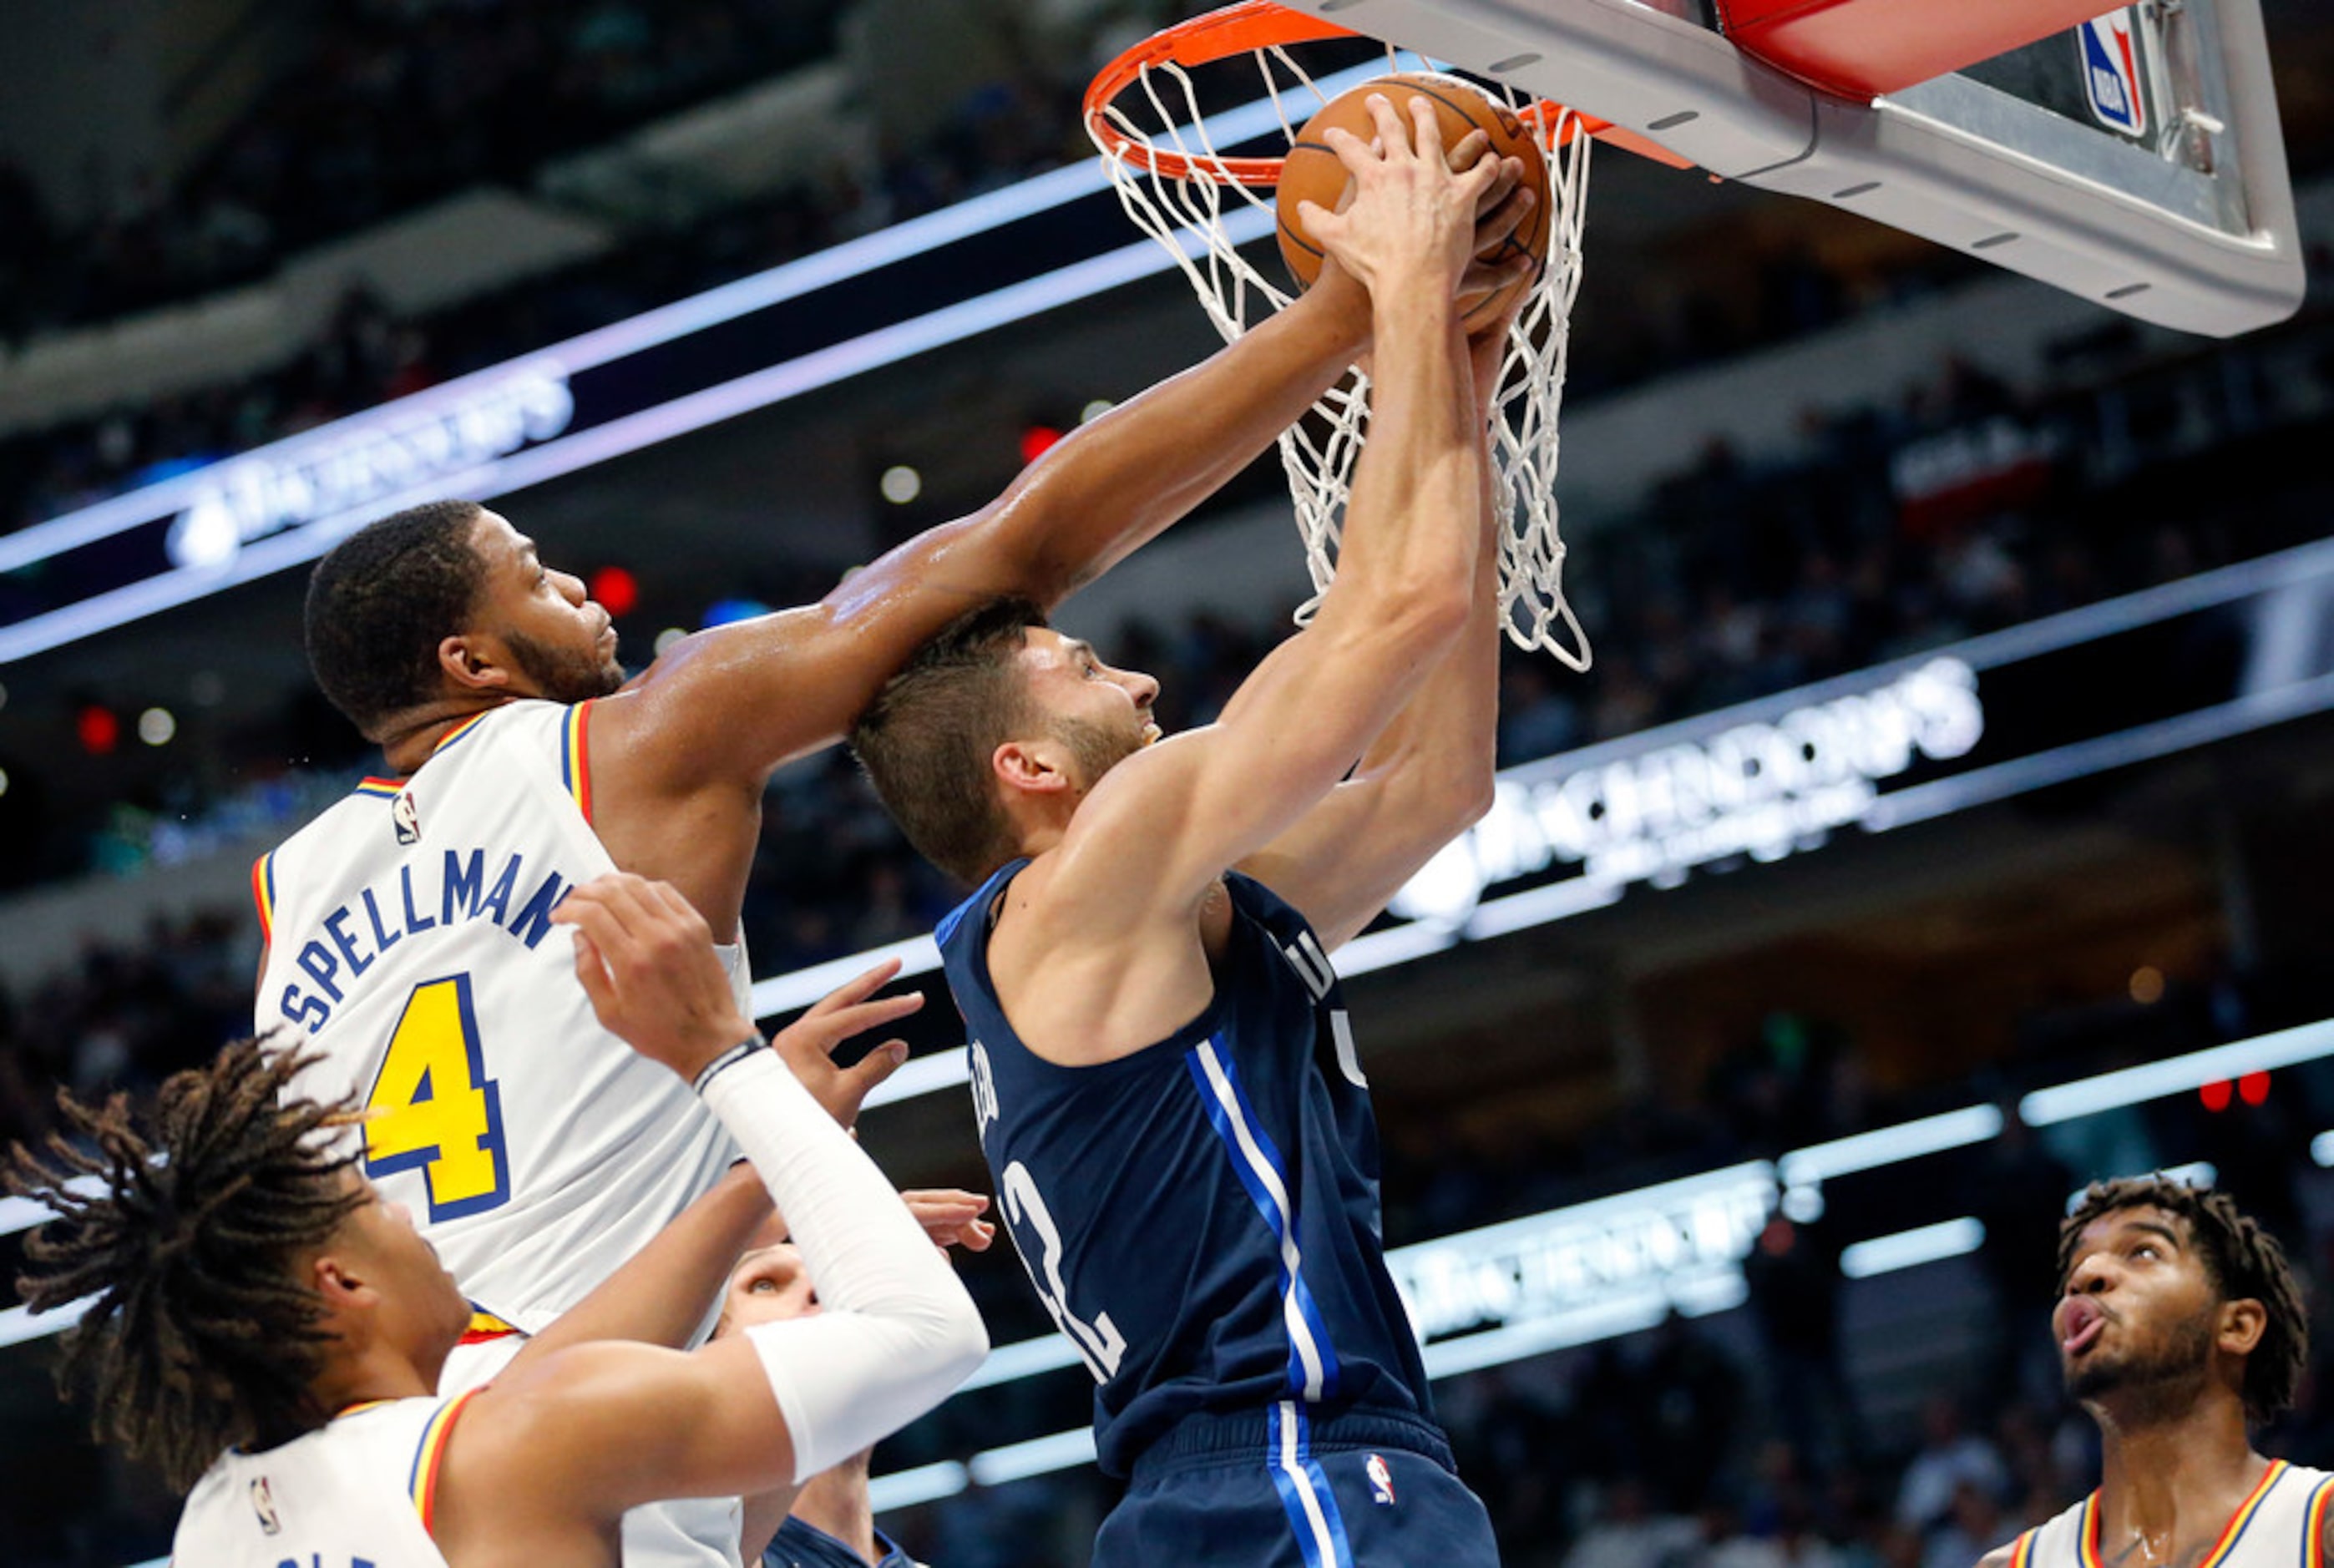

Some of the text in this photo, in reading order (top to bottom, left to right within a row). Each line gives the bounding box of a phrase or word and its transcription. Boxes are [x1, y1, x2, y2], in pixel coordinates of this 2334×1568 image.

[280, 847, 575, 1034] SPELLMAN
[360, 970, 511, 1225] 4
[997, 1159, 1128, 1387] 2
